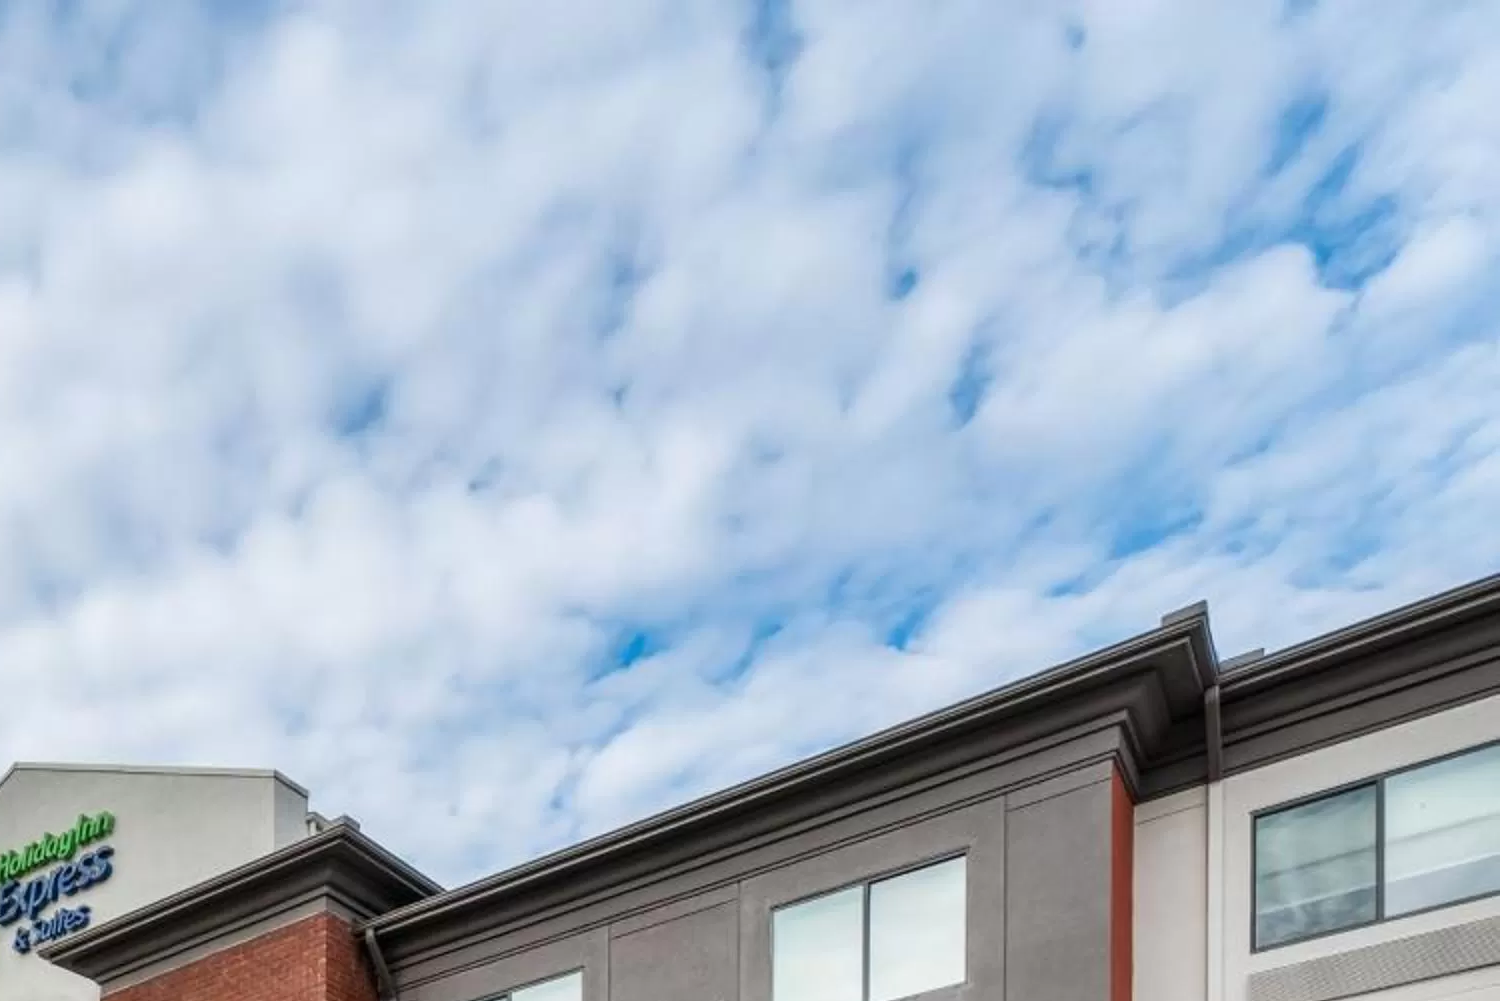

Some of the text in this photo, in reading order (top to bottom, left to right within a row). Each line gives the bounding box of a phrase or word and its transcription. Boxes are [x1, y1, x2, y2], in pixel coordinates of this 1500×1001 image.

[76, 812, 115, 846] Inn
[13, 906, 92, 954] & Suites
